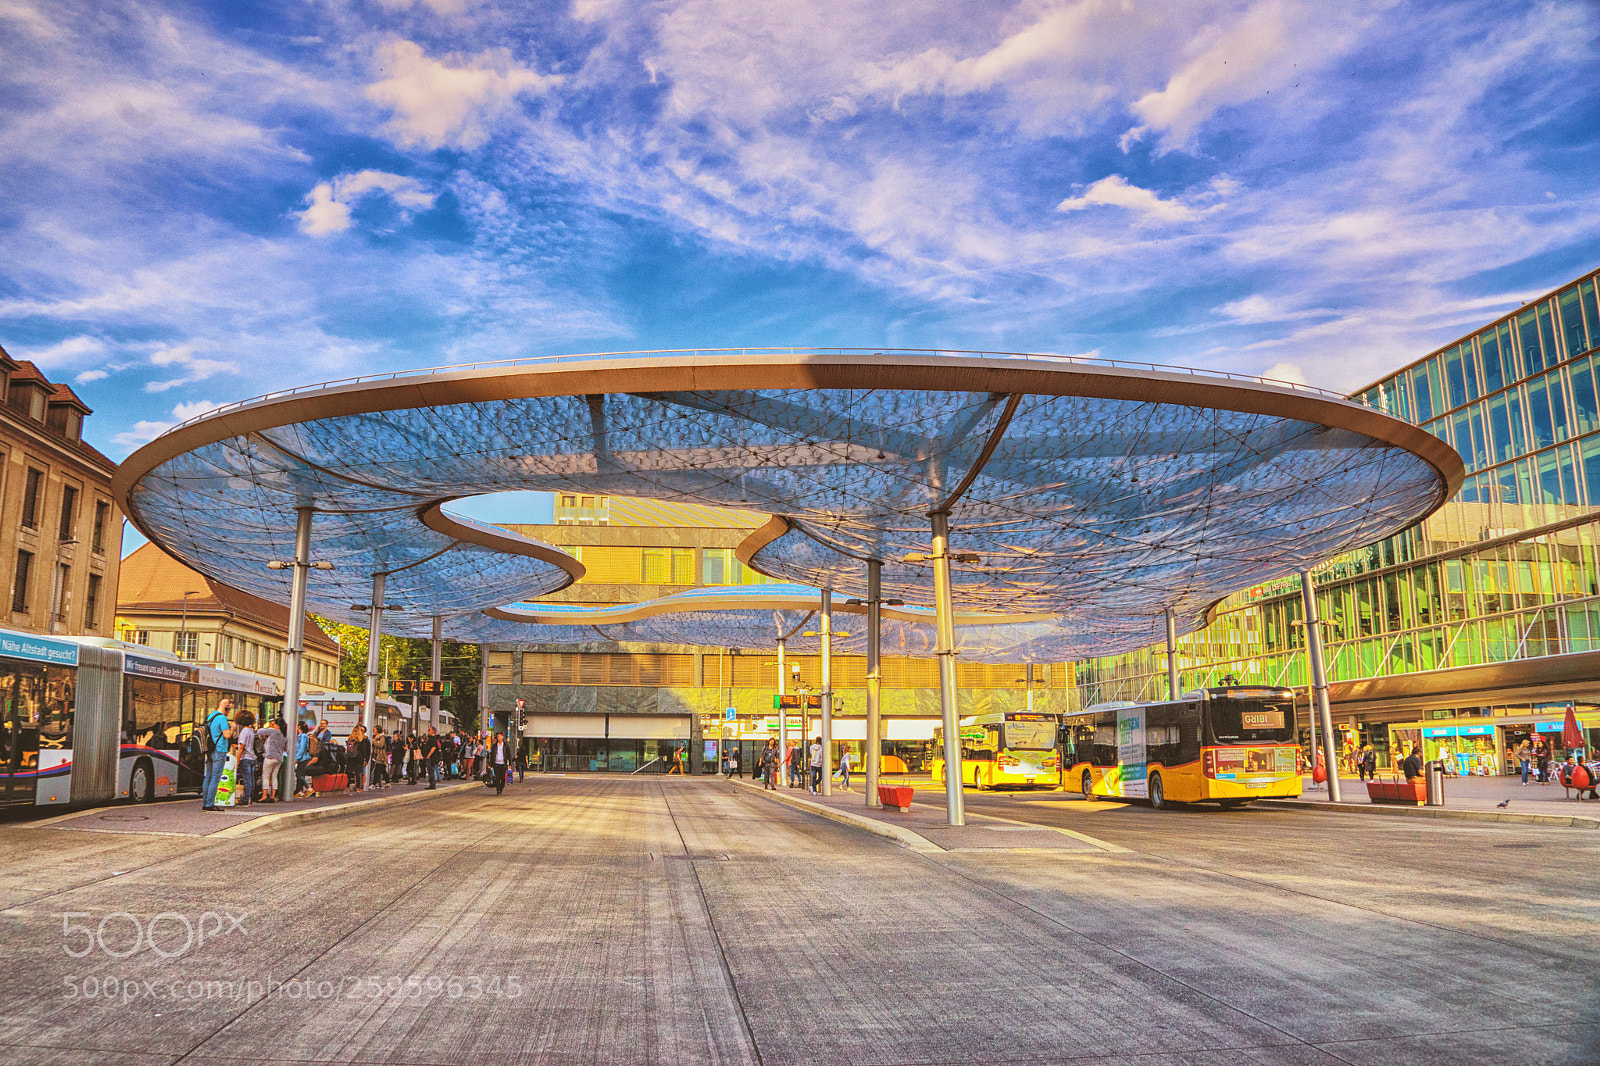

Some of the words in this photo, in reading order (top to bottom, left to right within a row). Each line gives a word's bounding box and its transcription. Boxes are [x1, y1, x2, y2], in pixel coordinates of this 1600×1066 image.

[2, 639, 20, 652] Nähe
[21, 642, 47, 656] Altstadt
[47, 649, 76, 660] gesucht?
